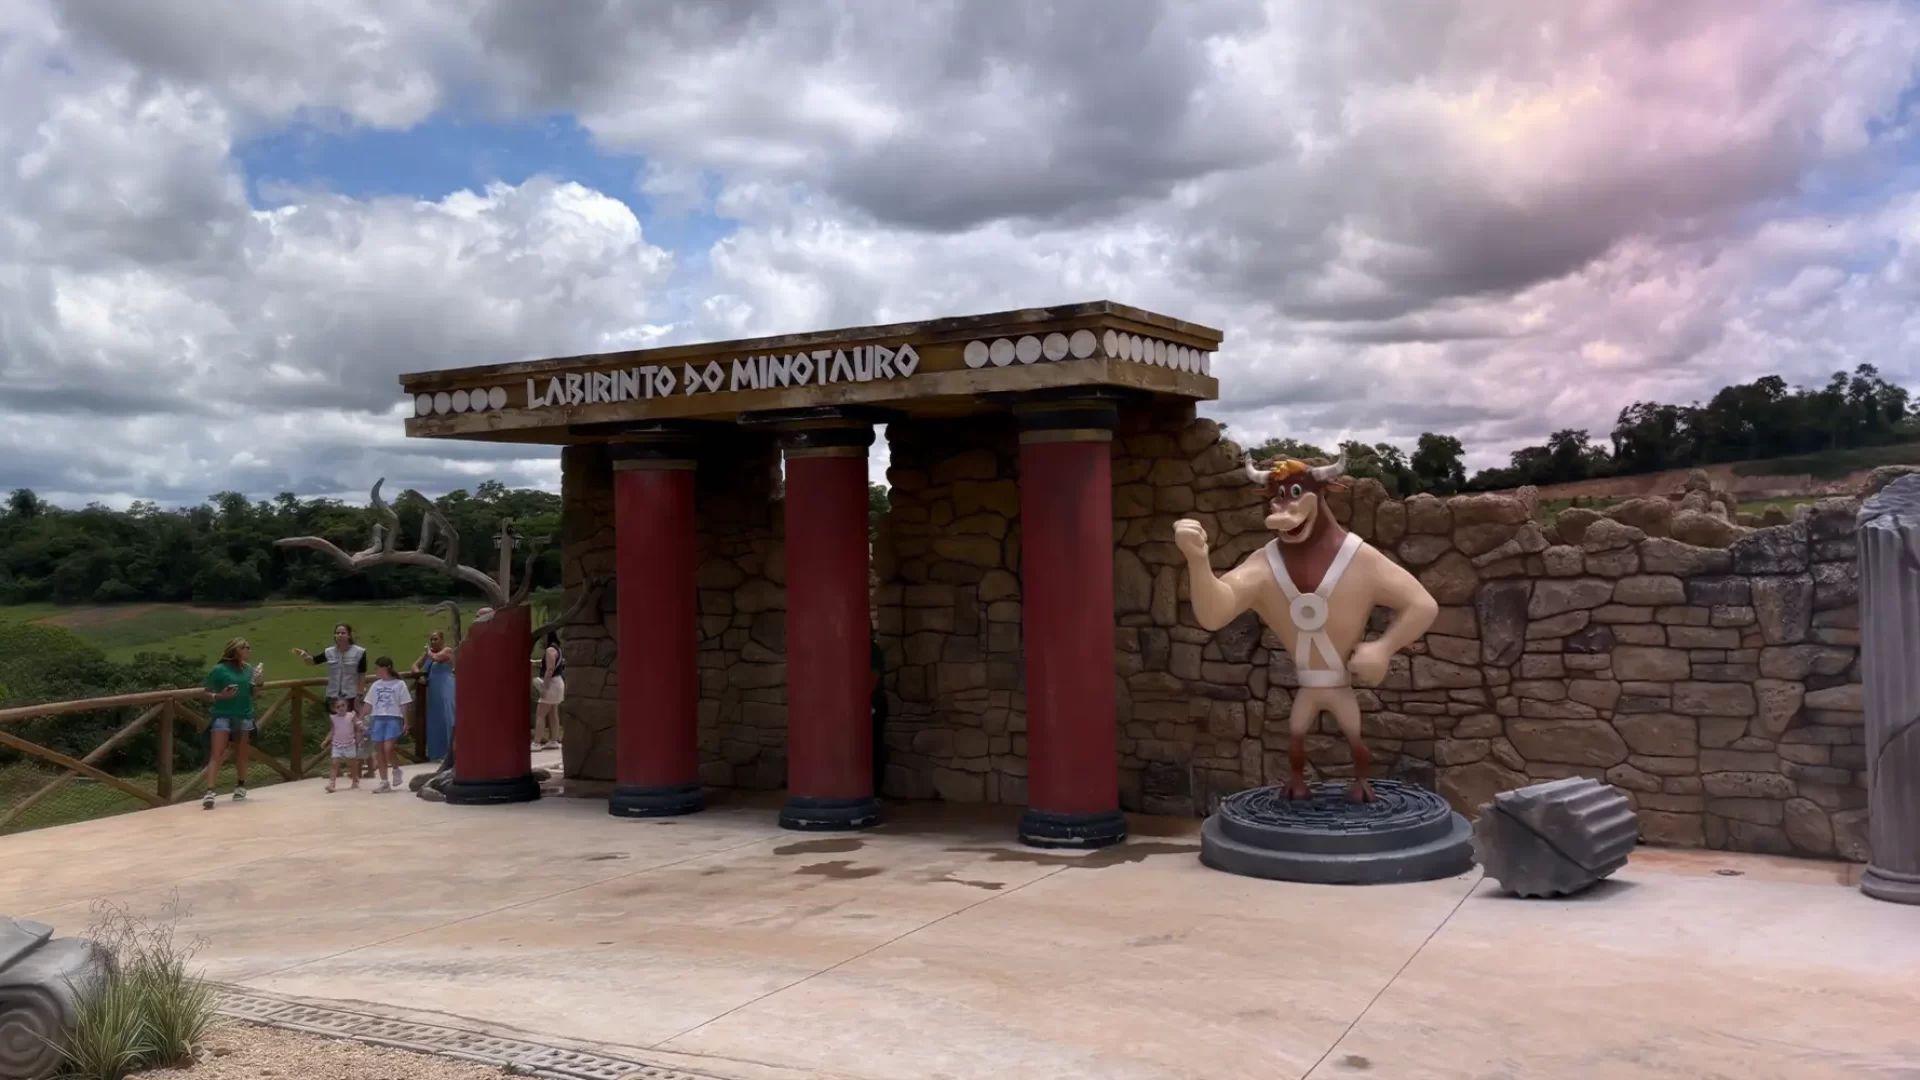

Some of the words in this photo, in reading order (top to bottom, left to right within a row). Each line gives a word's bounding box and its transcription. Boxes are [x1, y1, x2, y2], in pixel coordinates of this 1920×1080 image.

[526, 365, 677, 410] LABIRINTO
[684, 360, 726, 396] DO
[730, 343, 920, 392] MINOTAURO
